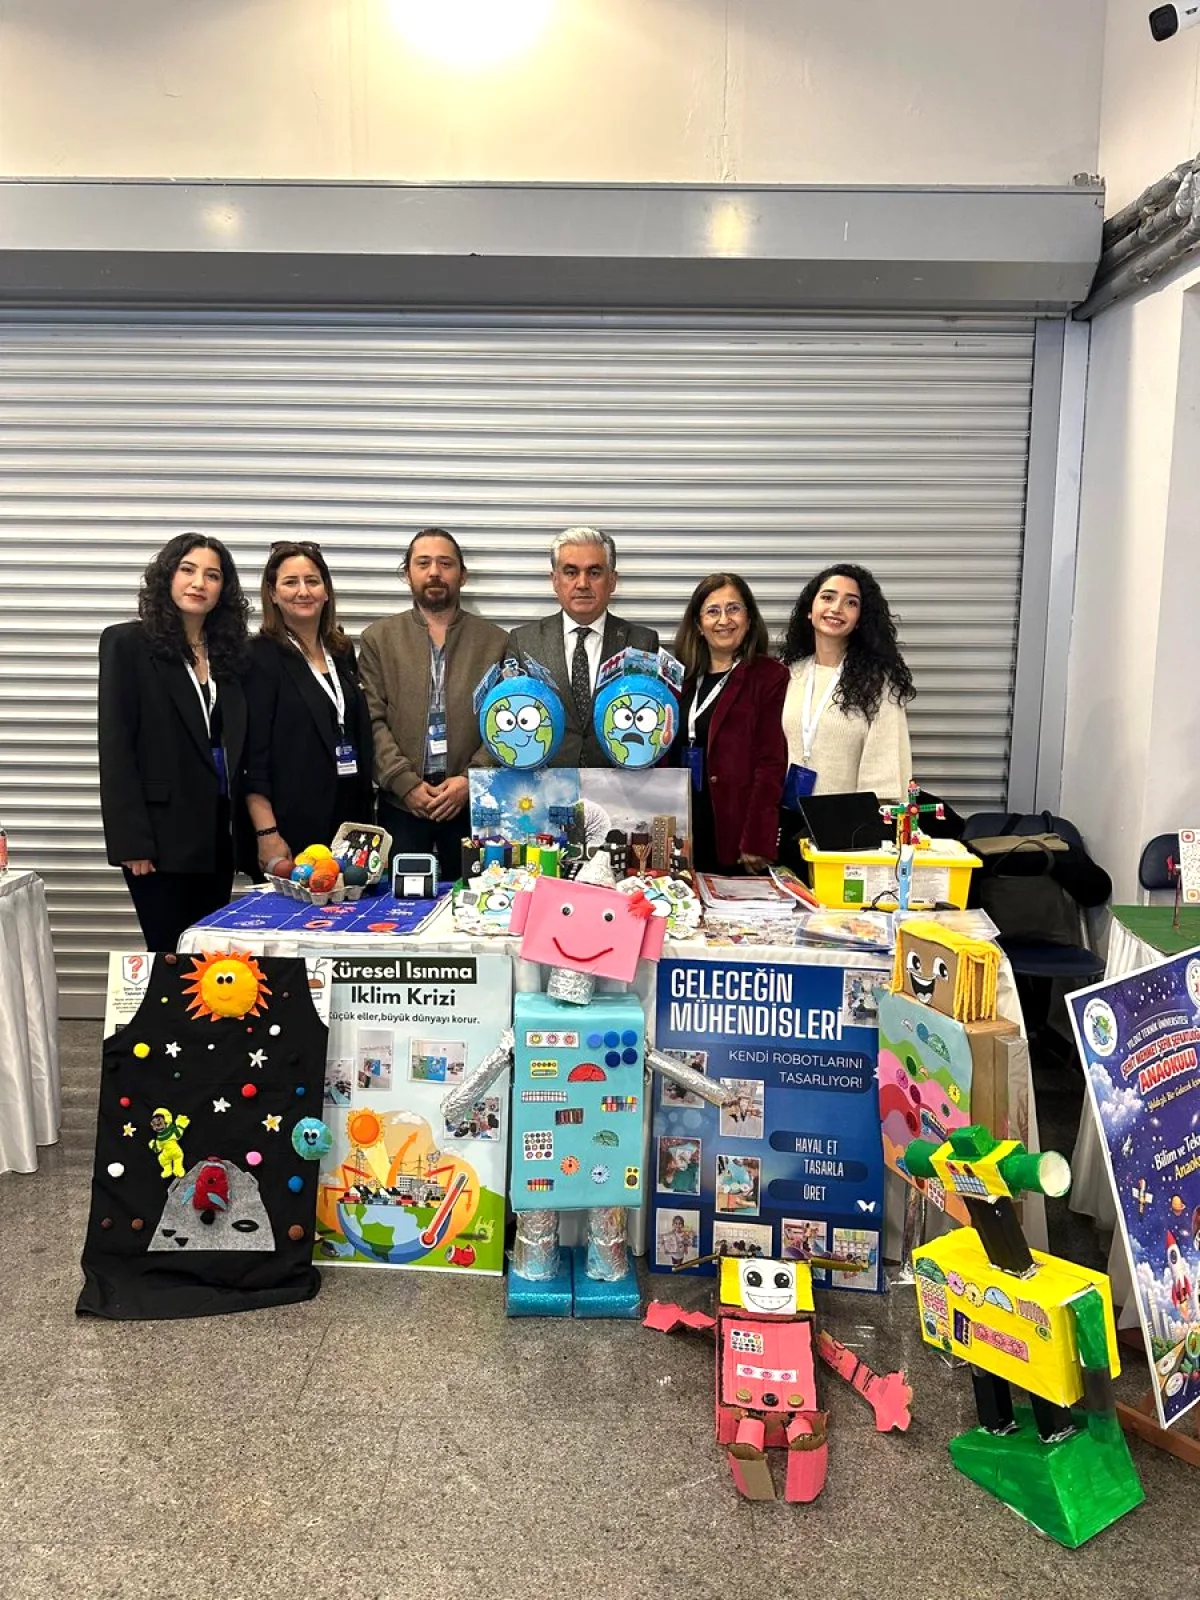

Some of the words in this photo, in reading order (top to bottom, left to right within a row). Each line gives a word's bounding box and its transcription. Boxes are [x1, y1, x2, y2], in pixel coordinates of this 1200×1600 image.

[332, 960, 400, 979] Küresel
[407, 961, 472, 979] Isınma
[671, 968, 793, 1004] GELECEĞİN
[407, 987, 455, 1006] Krizi
[412, 1013, 450, 1024] dünyayı
[452, 1013, 480, 1024] korur.
[669, 999, 842, 1041] MÜHENDİSLERİ
[728, 1049, 769, 1063] KENDİ
[772, 1052, 863, 1069] ROBOTLARINI
[779, 1071, 863, 1089] TASARLIYOR!
[1138, 1048, 1198, 1095] ANAOKULU
[795, 1137, 824, 1154] HAYAL
[827, 1139, 838, 1156] ET
[1154, 1148, 1178, 1171] Bilim
[1177, 1145, 1186, 1157] ve
[804, 1159, 844, 1177] TASARLA
